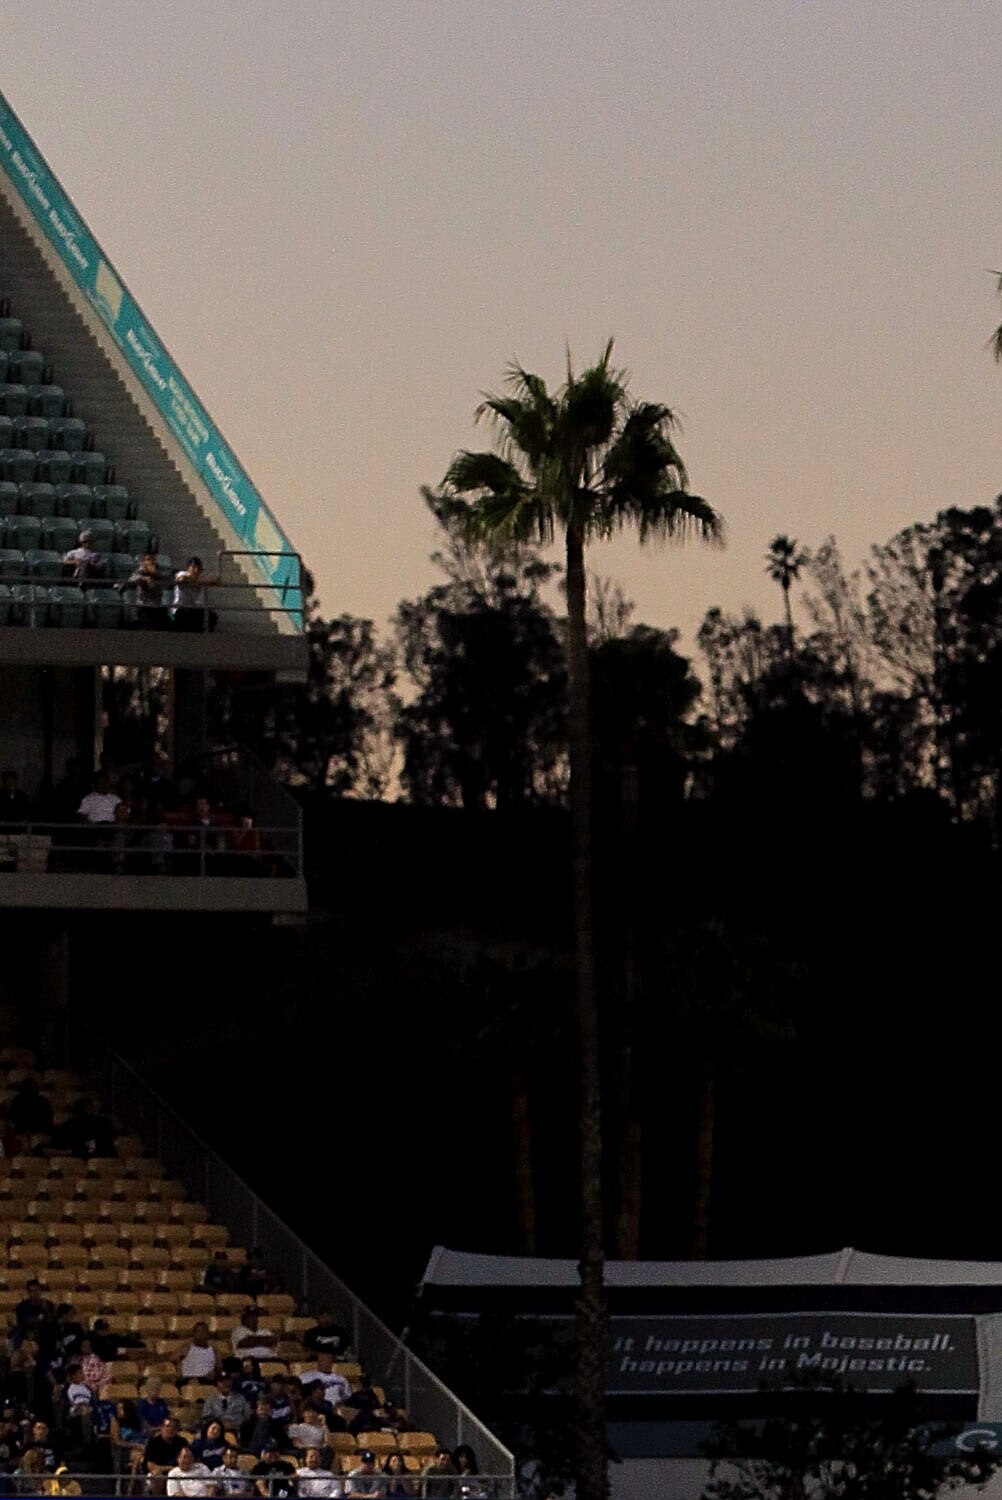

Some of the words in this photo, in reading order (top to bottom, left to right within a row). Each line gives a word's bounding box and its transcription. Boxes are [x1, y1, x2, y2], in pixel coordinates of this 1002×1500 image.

[613, 1336, 635, 1351] it
[645, 1335, 774, 1355] happens
[783, 1333, 810, 1350] in
[821, 1331, 955, 1351] baseball.
[619, 1356, 750, 1376] happens
[758, 1356, 789, 1372] in
[796, 1351, 932, 1374] Majestic.
